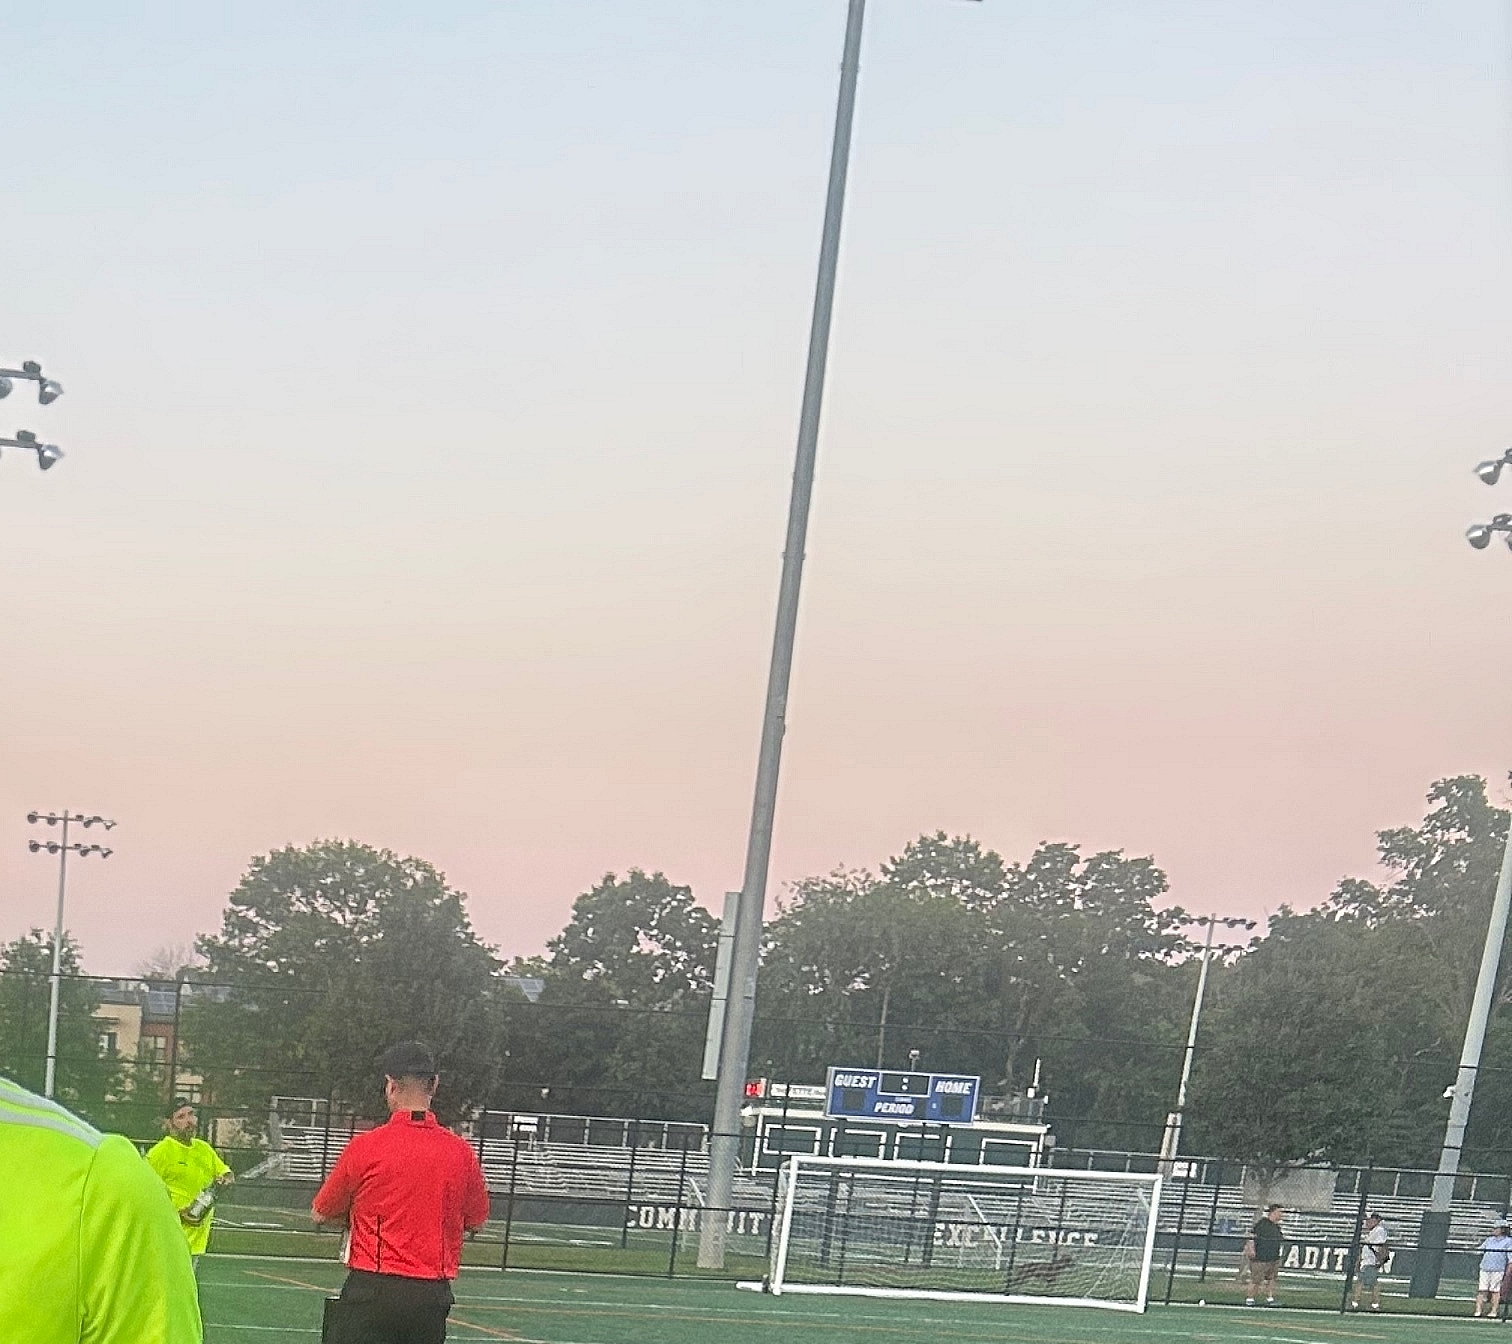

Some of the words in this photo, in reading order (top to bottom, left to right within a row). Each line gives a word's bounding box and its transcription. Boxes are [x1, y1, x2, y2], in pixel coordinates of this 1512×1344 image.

[834, 1074, 877, 1089] GUEST
[935, 1081, 973, 1095] HOME
[874, 1102, 915, 1115] PERIOD
